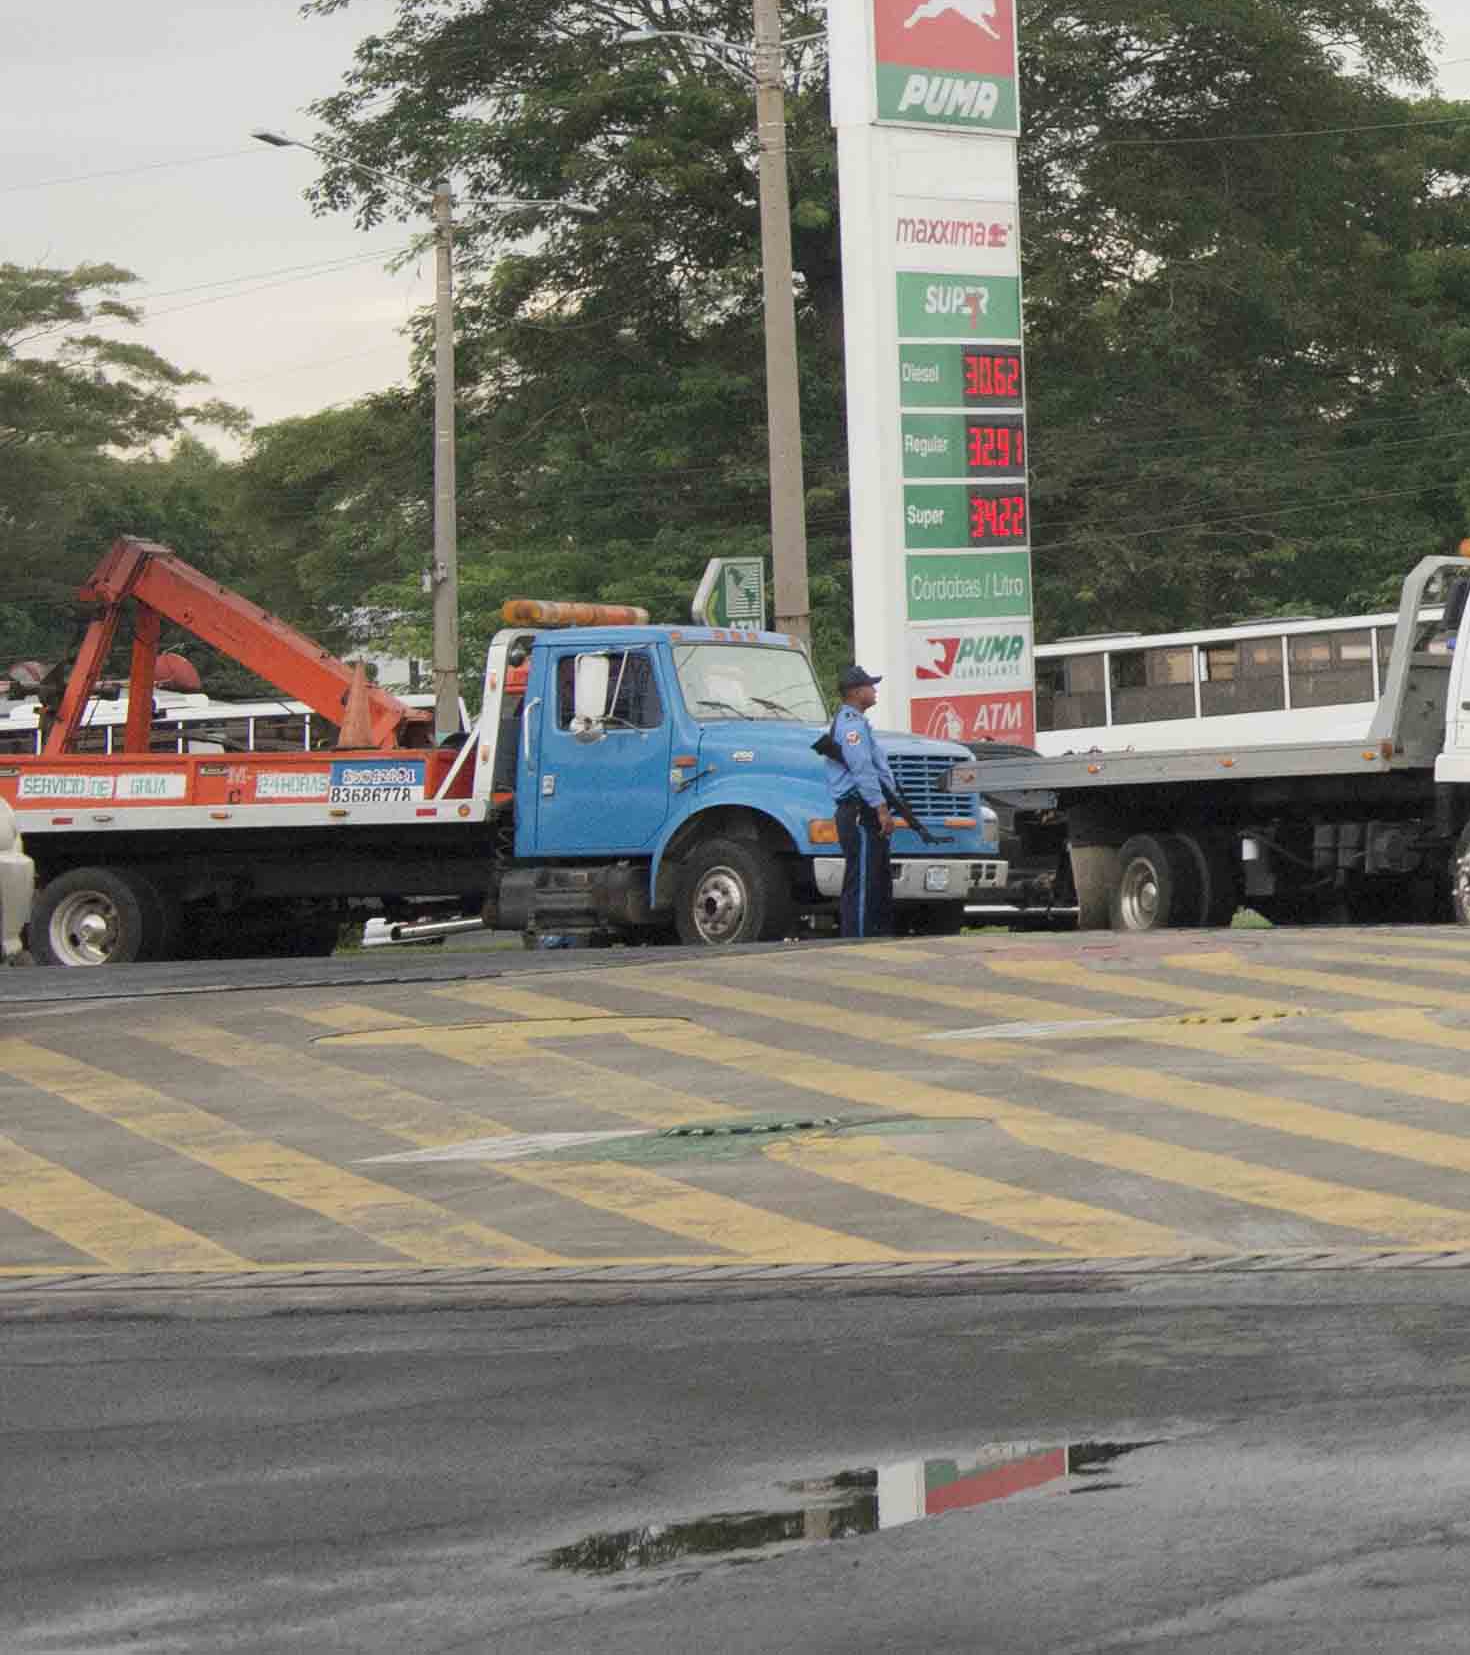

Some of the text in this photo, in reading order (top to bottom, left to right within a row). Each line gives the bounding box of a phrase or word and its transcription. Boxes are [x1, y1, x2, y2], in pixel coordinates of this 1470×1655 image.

[898, 75, 999, 119] PUMA
[896, 216, 986, 247] maxxima
[925, 285, 989, 314] SUPER
[902, 362, 940, 383] Diesel
[903, 433, 948, 457] Regular
[905, 504, 945, 530] Super
[957, 634, 1025, 664] PUMA
[972, 702, 1024, 733] ATM
[23, 776, 86, 795] SERVICIO
[90, 777, 111, 797] DE
